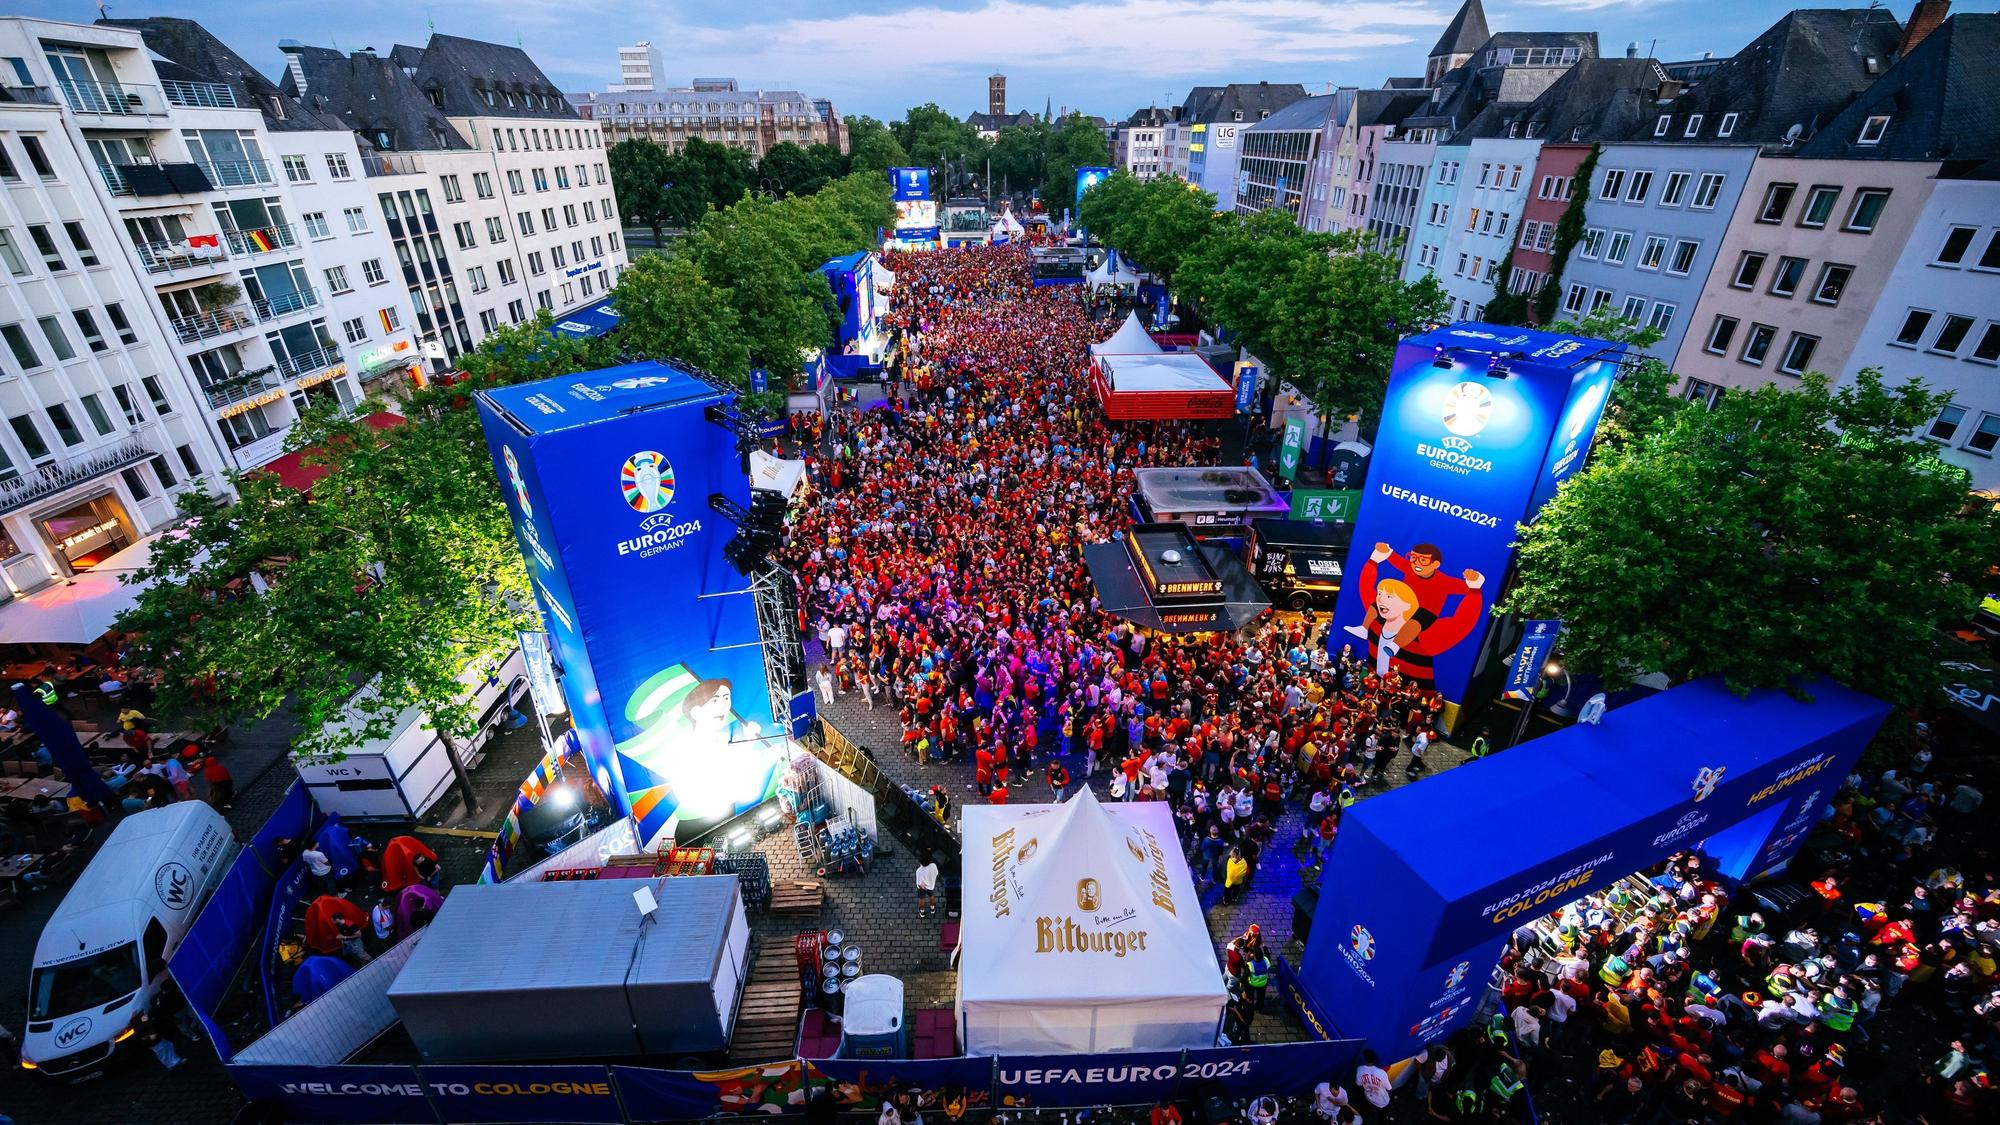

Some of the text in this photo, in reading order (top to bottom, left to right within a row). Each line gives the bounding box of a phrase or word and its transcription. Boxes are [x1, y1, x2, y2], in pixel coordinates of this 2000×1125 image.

[1217, 127, 1235, 138] LIG
[1416, 442, 1493, 473] EURO2024
[1442, 437, 1471, 454] UEFA
[1429, 459, 1471, 476] GERMANY
[640, 514, 672, 532] UEFA
[1216, 515, 1241, 523] Heumarkt
[617, 519, 702, 556] EURO2024
[639, 538, 685, 559] GERMANY
[1262, 564, 1283, 574] SONS
[1266, 552, 1286, 562] BUNS
[1307, 559, 1340, 568] CLOSED
[1167, 582, 1214, 593] BRENNWERK
[326, 768, 350, 776] WC
[1775, 752, 1825, 782] FAN ZONE
[1746, 755, 1837, 807] HEUMARKT
[191, 823, 214, 860] IHR PARTNER
[205, 829, 219, 851] MOBILE
[1652, 813, 1709, 847] EURO2024
[207, 836, 224, 864] TOILETTEN
[989, 827, 1016, 919] Bitburger
[1142, 828, 1177, 918] Bitburger
[1481, 851, 1614, 917] EURO 2024 FESTIVAL
[166, 869, 187, 904] WC
[1492, 869, 1595, 924] COLOGNE
[1123, 908, 1136, 918] Bit
[1034, 915, 1148, 958] Bitburger
[41, 938, 126, 966] wc-vermietung.nrw
[1337, 943, 1376, 988] EURO2024
[1288, 983, 1331, 1041] COLOGN
[57, 1022, 87, 1045] WC
[1182, 1060, 1252, 1079] 2024
[279, 1081, 611, 1097] WELCOME TO COLOGNE
